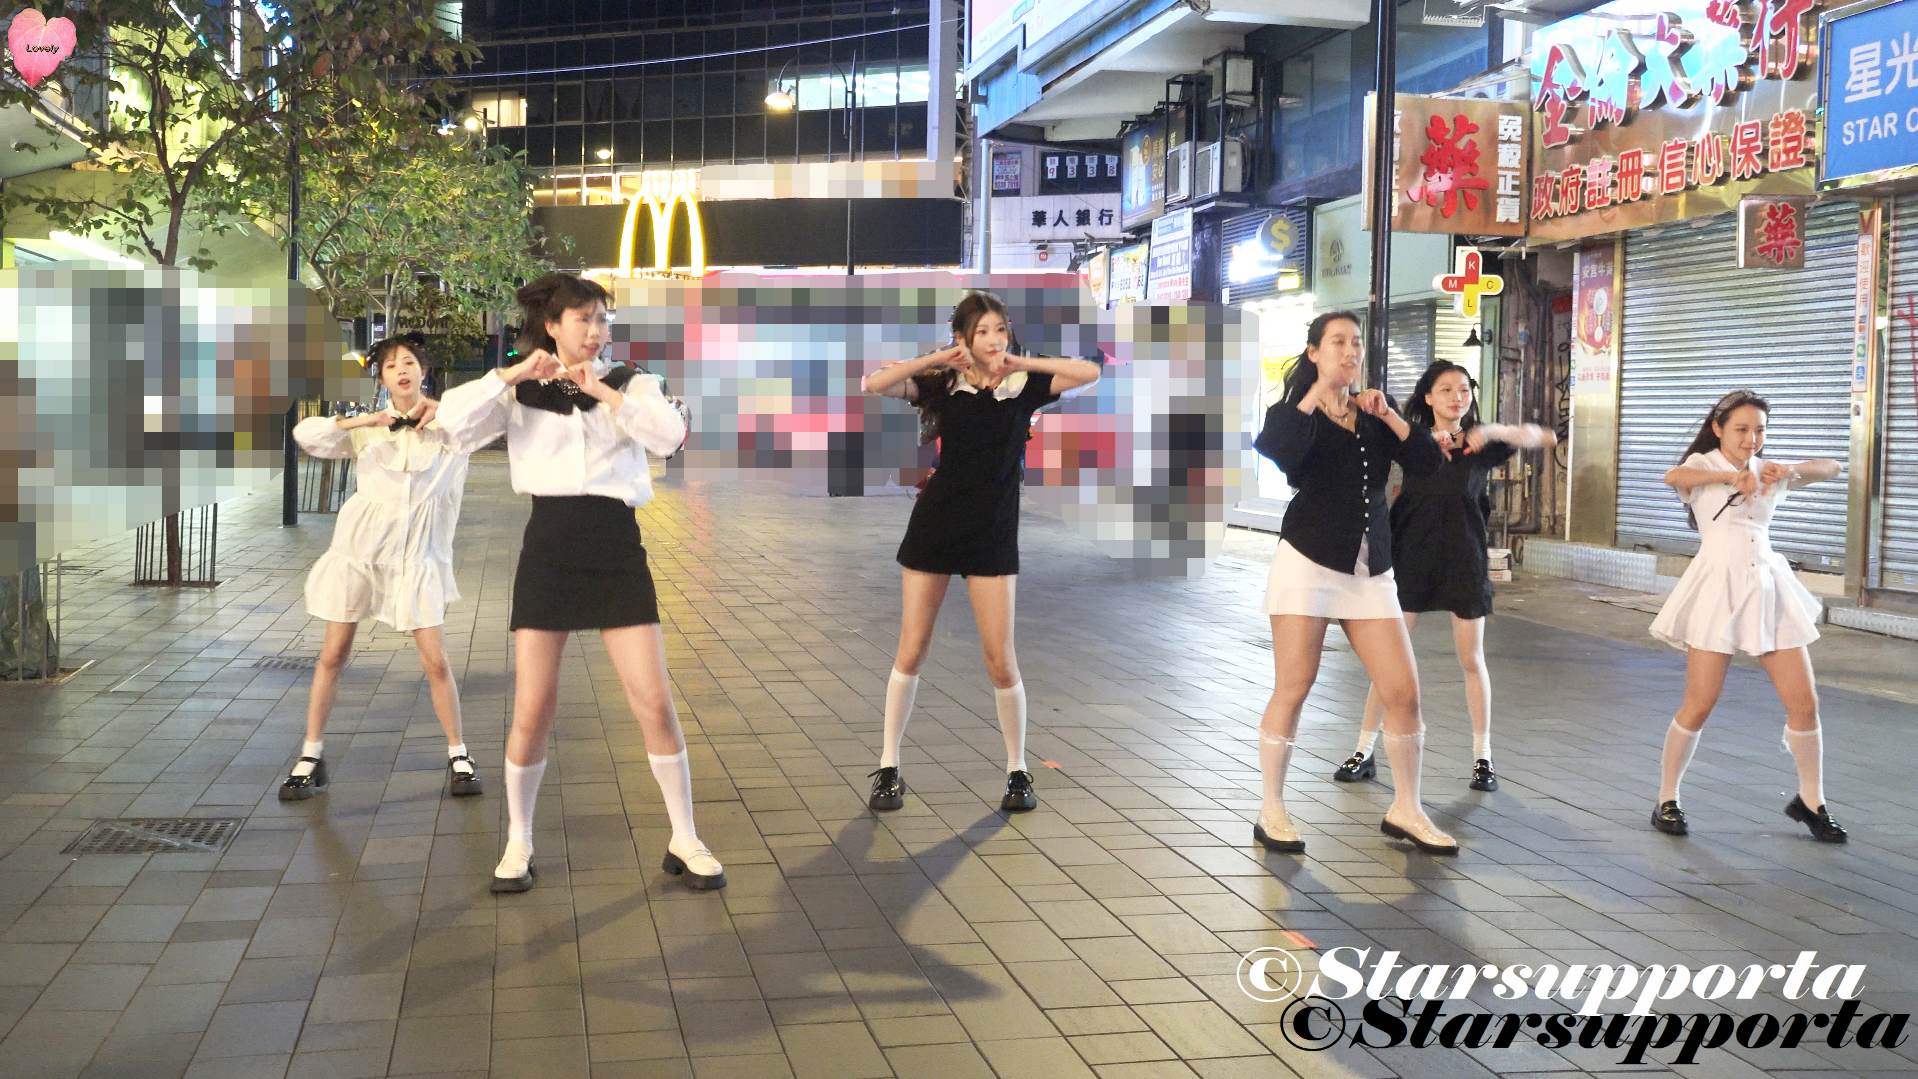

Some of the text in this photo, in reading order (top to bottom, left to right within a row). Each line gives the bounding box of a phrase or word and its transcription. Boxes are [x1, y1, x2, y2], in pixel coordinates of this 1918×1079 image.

[1844, 32, 1918, 104] 星光
[1842, 112, 1898, 146] STAR
[1406, 114, 1489, 219] 藥
[1530, 108, 1807, 221] 政府註冊 信心保證
[1032, 208, 1114, 228] 華人銀行
[1756, 202, 1803, 265] 藥
[1468, 260, 1476, 270] K
[1448, 279, 1494, 290] M C
[1467, 298, 1473, 308] L
